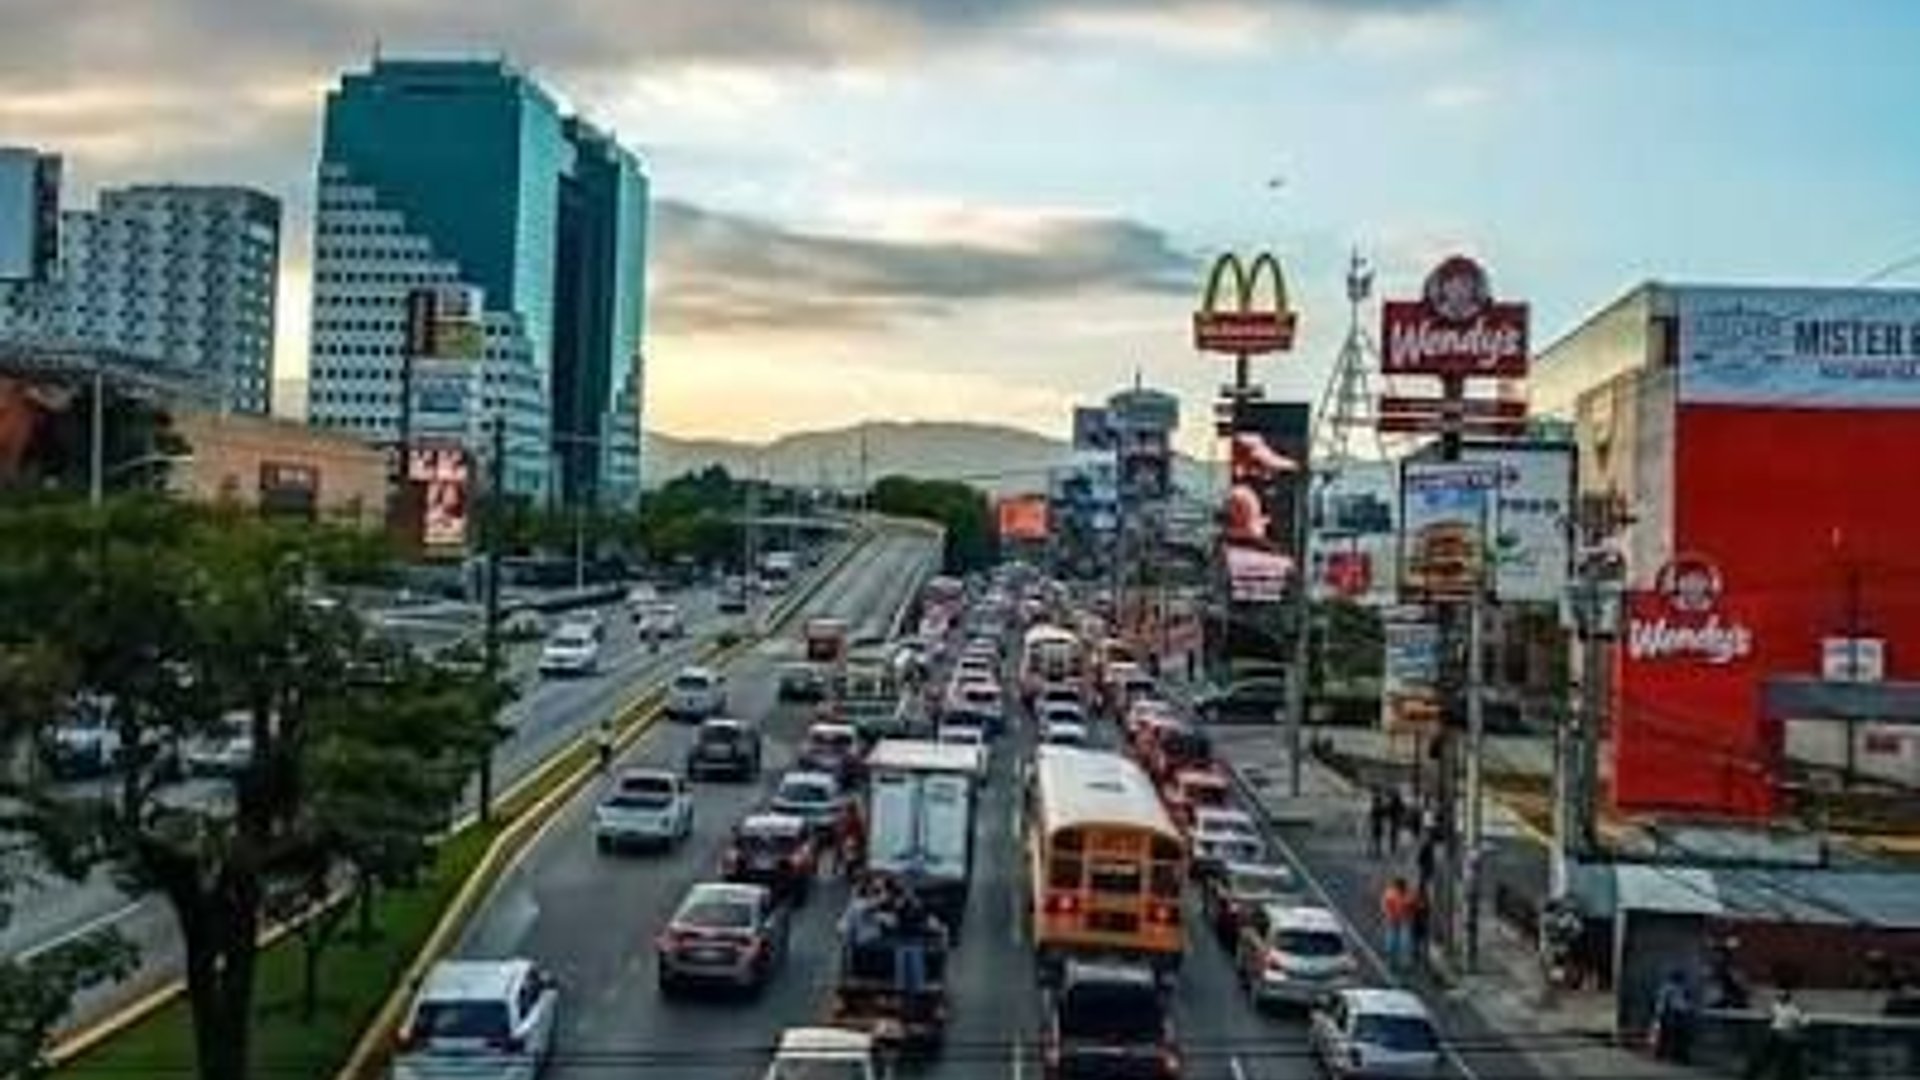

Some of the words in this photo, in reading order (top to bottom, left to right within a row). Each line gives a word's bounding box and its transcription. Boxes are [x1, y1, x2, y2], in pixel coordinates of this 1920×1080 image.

[1389, 318, 1520, 367] Wendy's
[1794, 320, 1902, 355] MISTER
[1629, 614, 1752, 662] Wendy's
